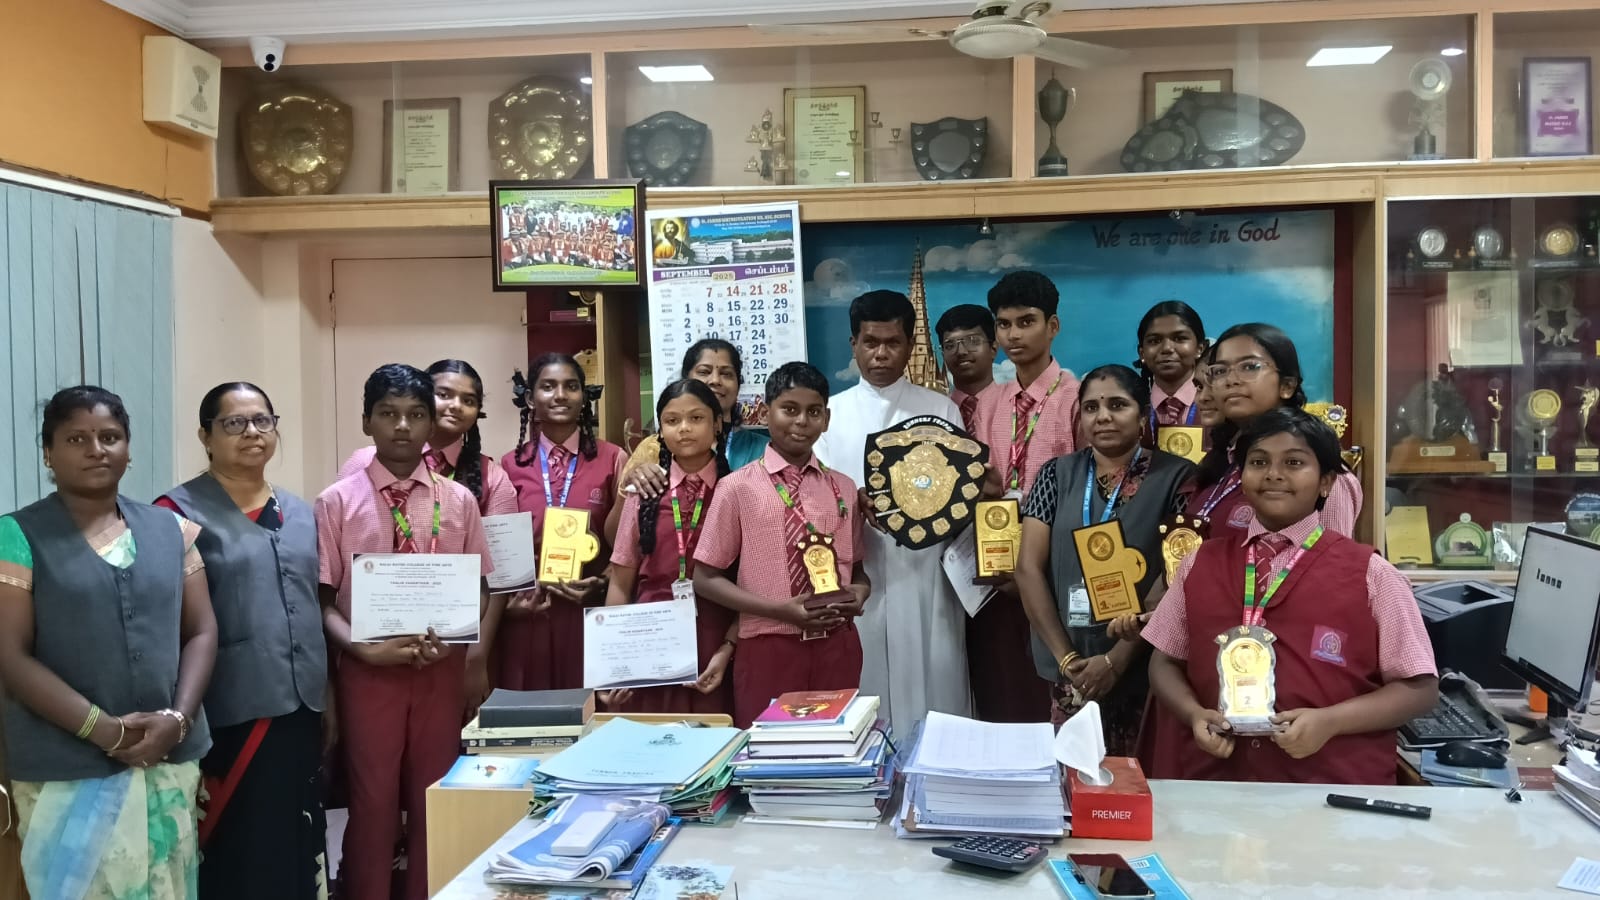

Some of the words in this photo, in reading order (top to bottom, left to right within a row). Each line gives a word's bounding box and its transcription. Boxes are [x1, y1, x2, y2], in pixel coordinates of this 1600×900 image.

[1091, 219, 1122, 249] We
[1129, 231, 1162, 247] are
[1167, 228, 1200, 246] one
[1209, 223, 1230, 244] in
[1238, 218, 1281, 243] God
[660, 268, 710, 278] SEPTEMBER
[744, 264, 790, 275] செப்டம்பர்
[706, 287, 713, 298] 7
[726, 285, 740, 297] 14
[750, 284, 764, 296] 21
[772, 283, 788, 294] 28
[684, 303, 691, 314] 1
[706, 302, 714, 313] 8
[727, 300, 741, 312] 15
[750, 299, 764, 310] 22
[773, 298, 788, 309] 29
[684, 318, 691, 329] 2
[707, 316, 714, 327] 9
[728, 315, 742, 326] 16
[750, 314, 765, 325] 23
[774, 312, 789, 324] 30
[684, 333, 692, 344] 3
[729, 330, 742, 341] 17
[751, 329, 766, 340] 24
[752, 344, 767, 355] 25
[752, 358, 768, 370] 26
[753, 374, 767, 384] 27
[986, 560, 994, 568] 1
[1100, 600, 1110, 610] 1
[1092, 810, 1132, 820] PREMIER
